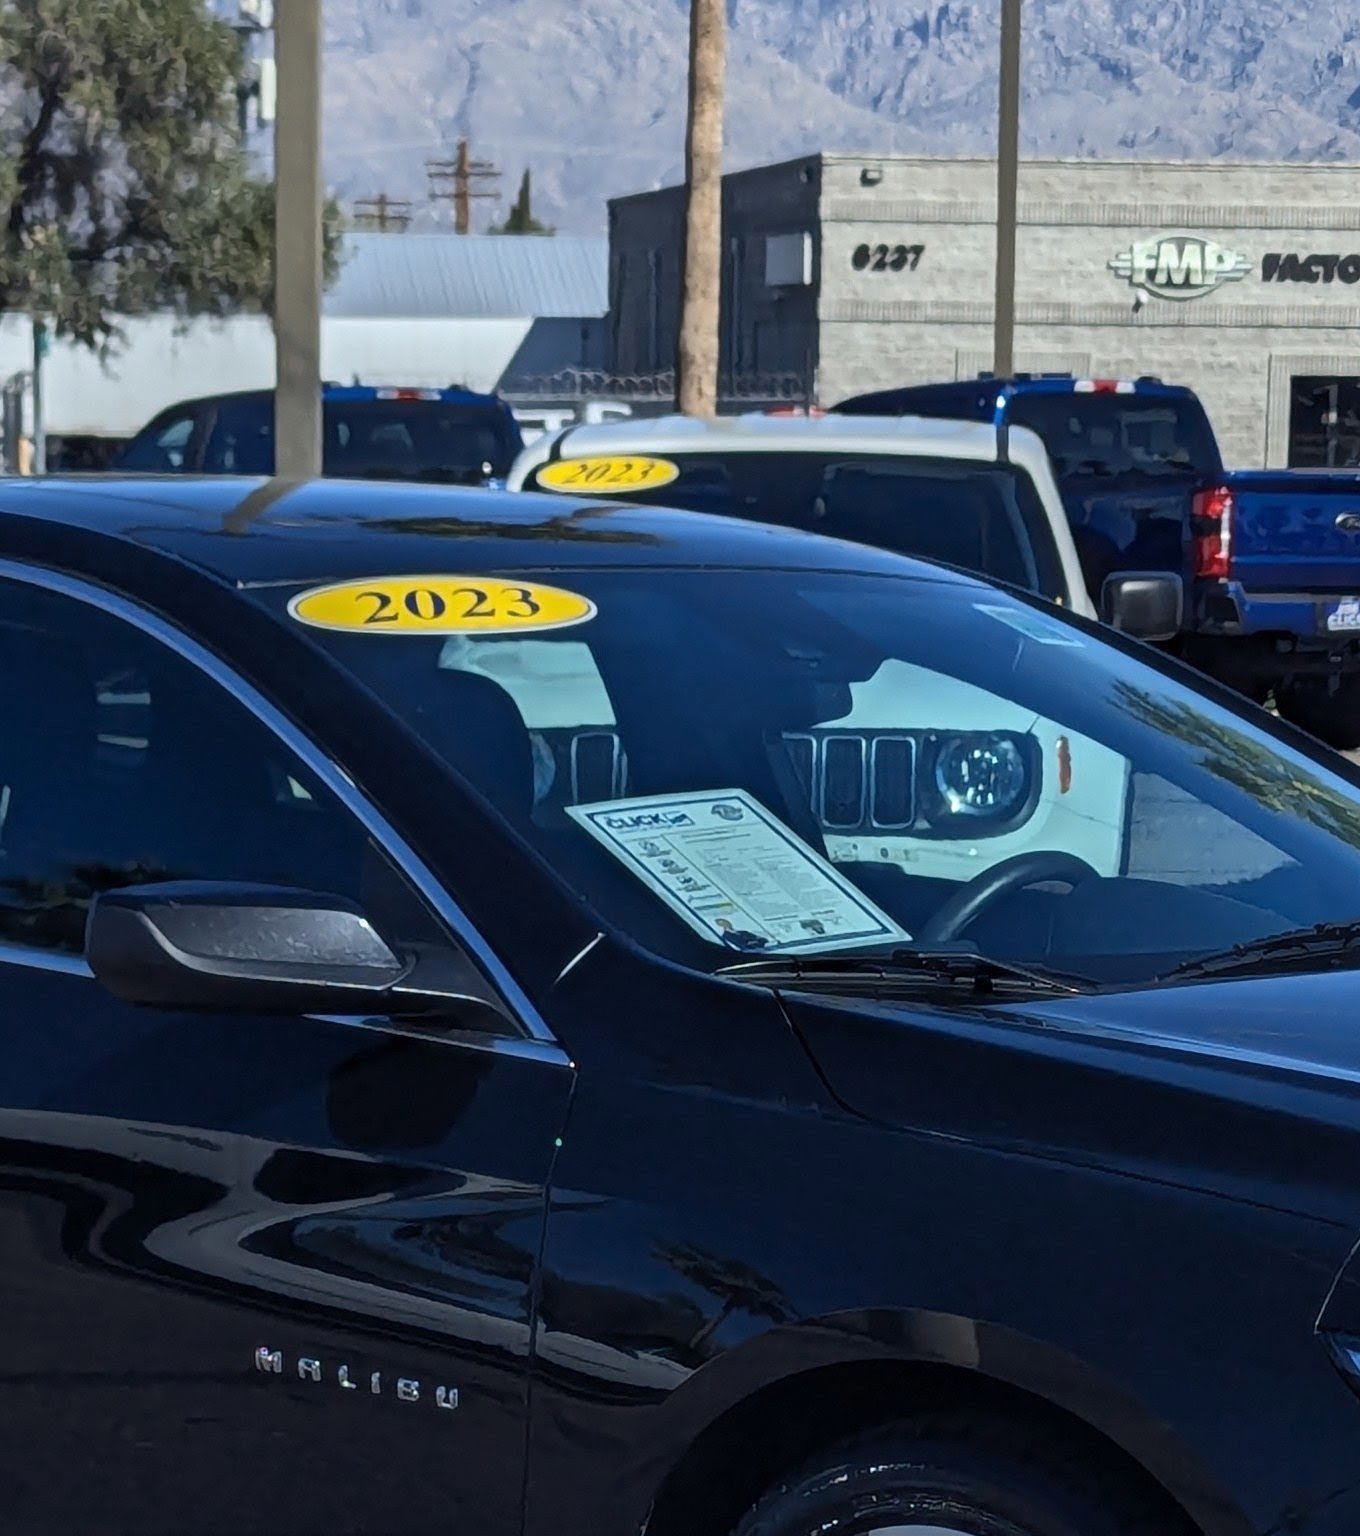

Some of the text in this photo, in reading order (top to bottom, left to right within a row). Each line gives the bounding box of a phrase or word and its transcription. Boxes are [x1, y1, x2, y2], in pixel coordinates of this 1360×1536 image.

[851, 243, 925, 272] 6237
[1131, 242, 1237, 285] FMP
[562, 461, 656, 484] 2023
[355, 587, 540, 624] 2023
[255, 1347, 459, 1410] MALIBU
